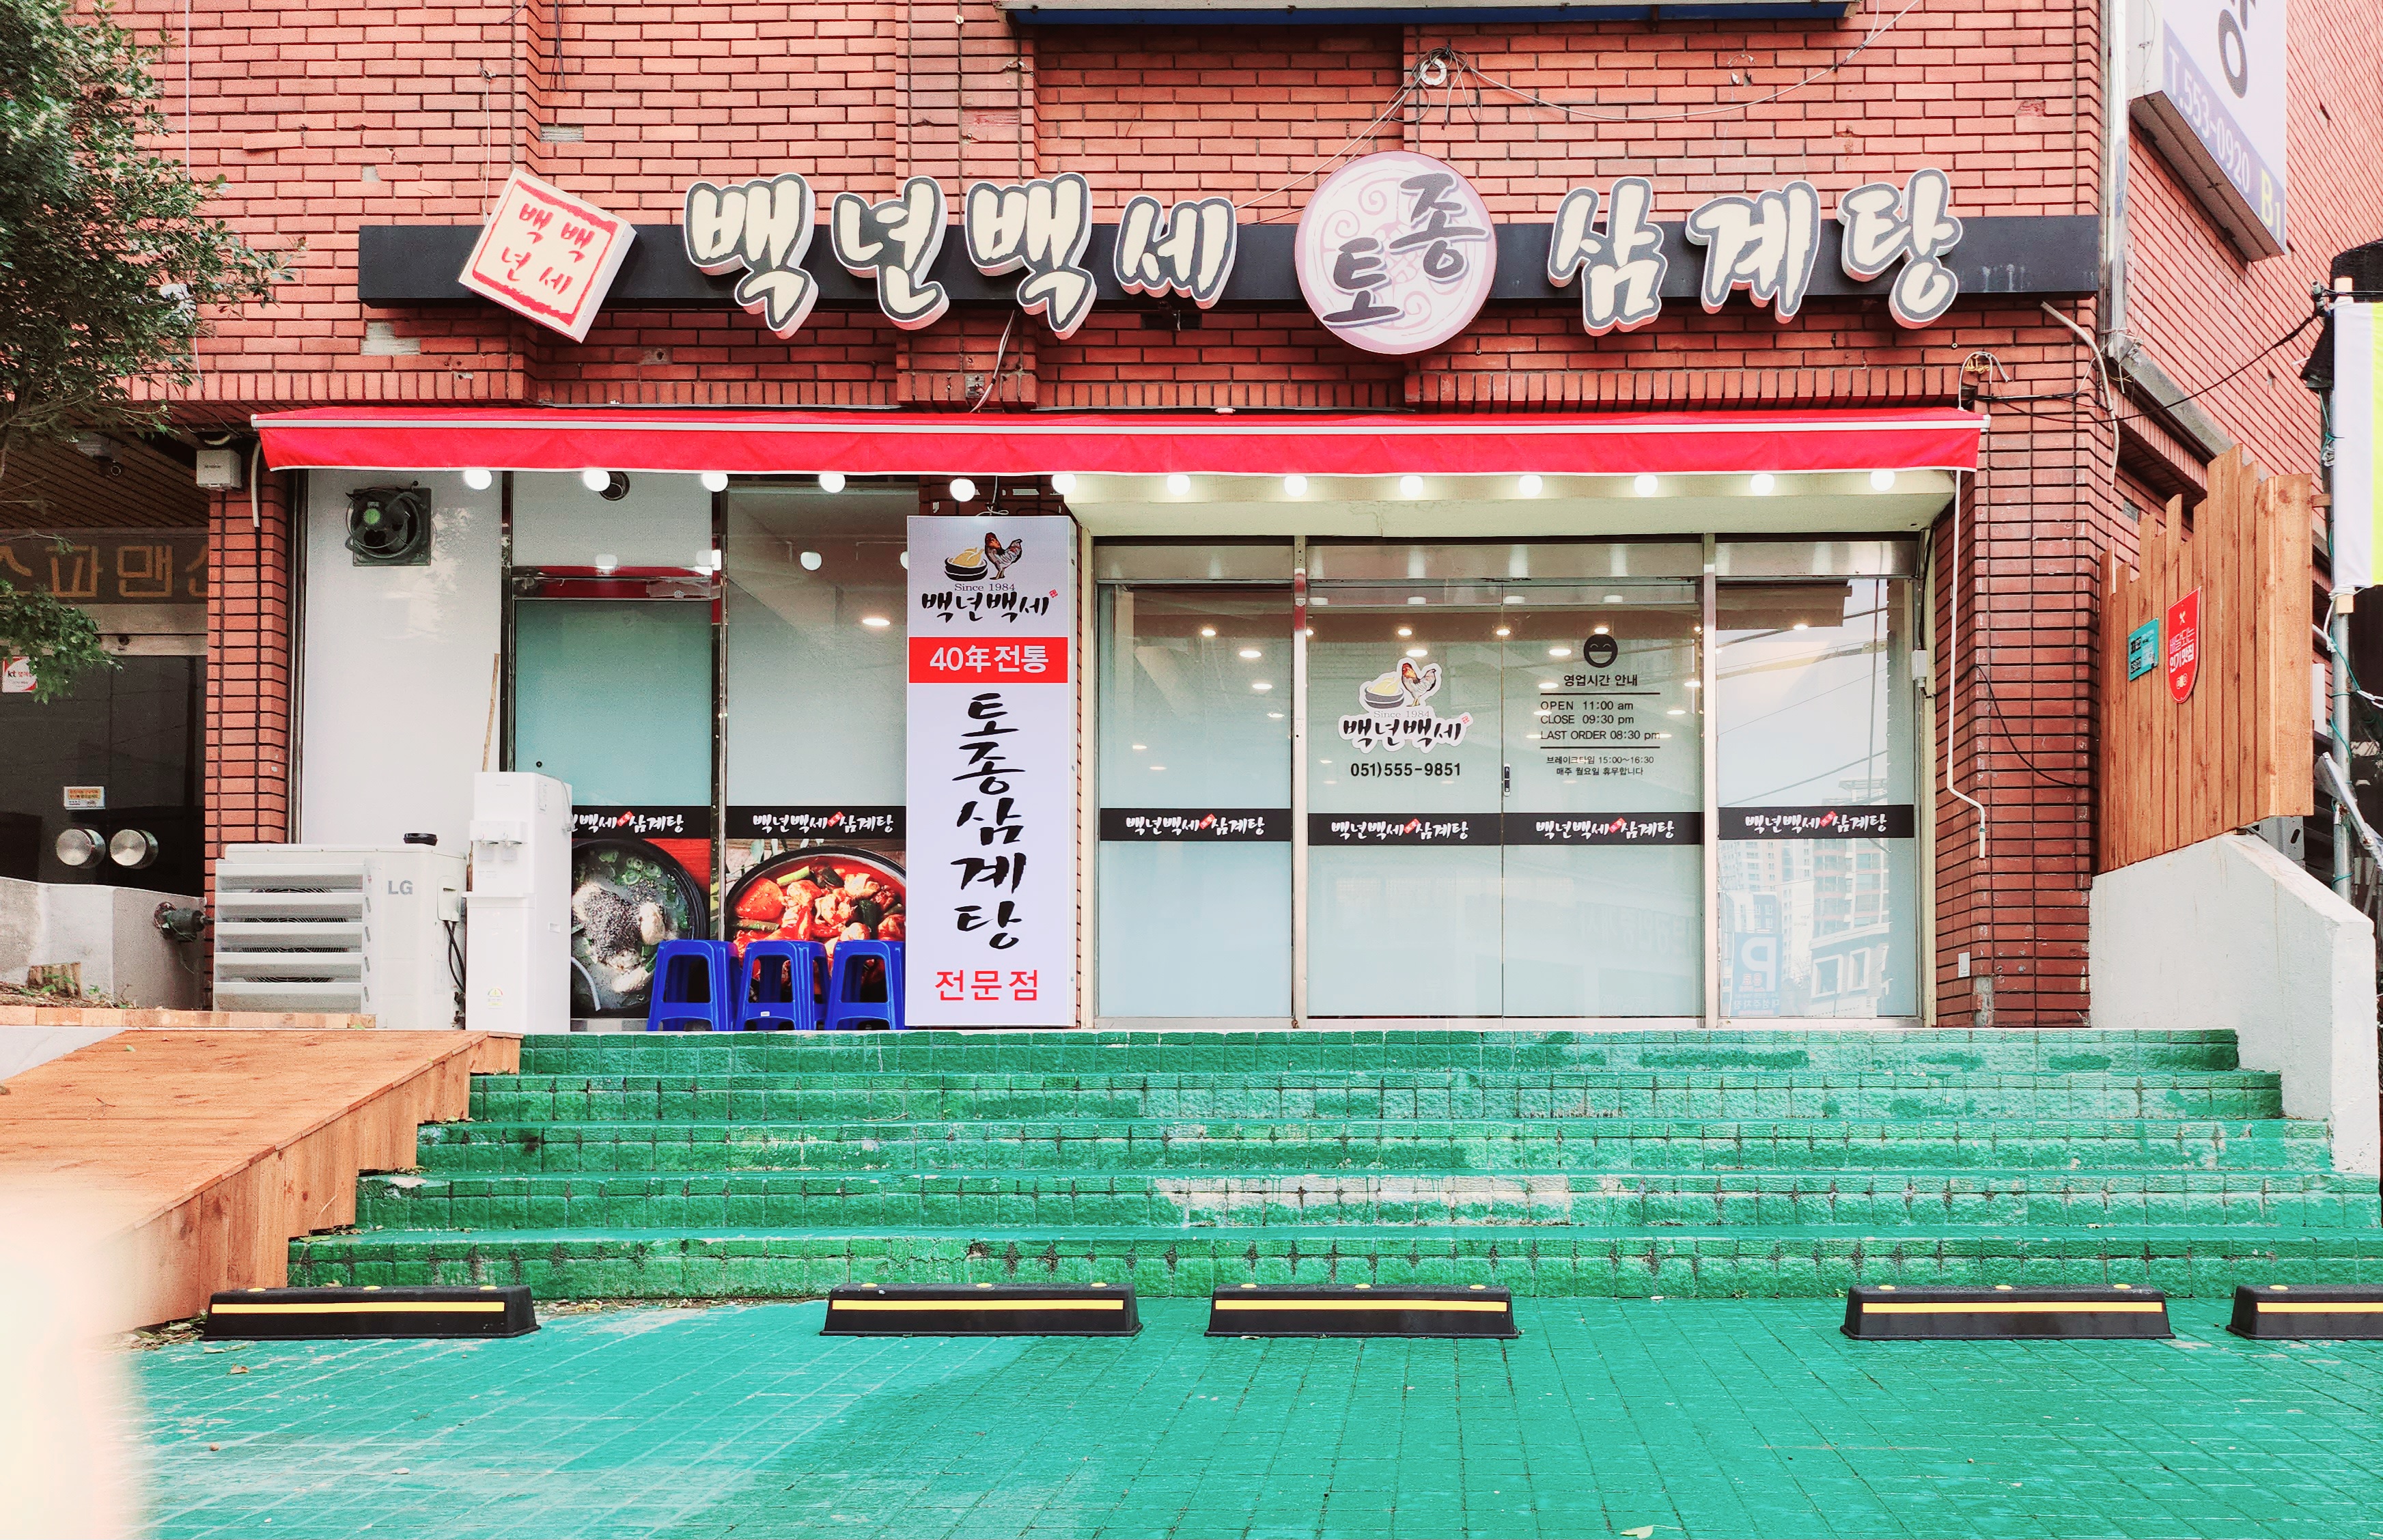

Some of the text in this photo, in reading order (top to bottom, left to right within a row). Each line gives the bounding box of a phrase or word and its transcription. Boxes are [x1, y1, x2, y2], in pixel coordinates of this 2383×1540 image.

[2168, 44, 2250, 194] T.553-0920
[2261, 168, 2282, 239] B1
[684, 167, 1964, 340] 백년백세 토종 삼계탕
[0, 544, 208, 598] 파맨
[954, 583, 1016, 591] Since 1984
[921, 591, 1050, 624] 백년백세
[1563, 674, 1638, 687] 영업시간 안내
[1540, 701, 1574, 710] OPEN
[1583, 701, 1614, 710] 11:00
[1540, 714, 1634, 726] CLOSE 09:30 pm
[1343, 718, 1462, 748] 백년백세
[1540, 730, 1660, 741] LAST ORDER 08:30 pm
[1350, 761, 1461, 778] 051)555-9851
[1599, 756, 1654, 764] 15:00~16:30
[1556, 767, 1644, 776] 매주 월요일 휴무합니다
[629, 814, 684, 833] 삼계탕
[753, 813, 828, 833] 백년백세
[839, 814, 893, 833] 삼계탕
[951, 692, 1027, 951] 토종삼계탕
[1126, 816, 1200, 836] 백년백세
[1211, 817, 1266, 836] 삼계탕
[1331, 821, 1406, 841] 백년백세
[1415, 821, 1469, 840] 삼계탕
[1535, 820, 1611, 840] 백년백세
[1620, 820, 1675, 839] 삼계탕
[1745, 814, 1820, 835] 백년백세
[1832, 813, 1888, 833] 삼계탕
[387, 880, 413, 895] LG
[934, 968, 1038, 1002] 전문점
